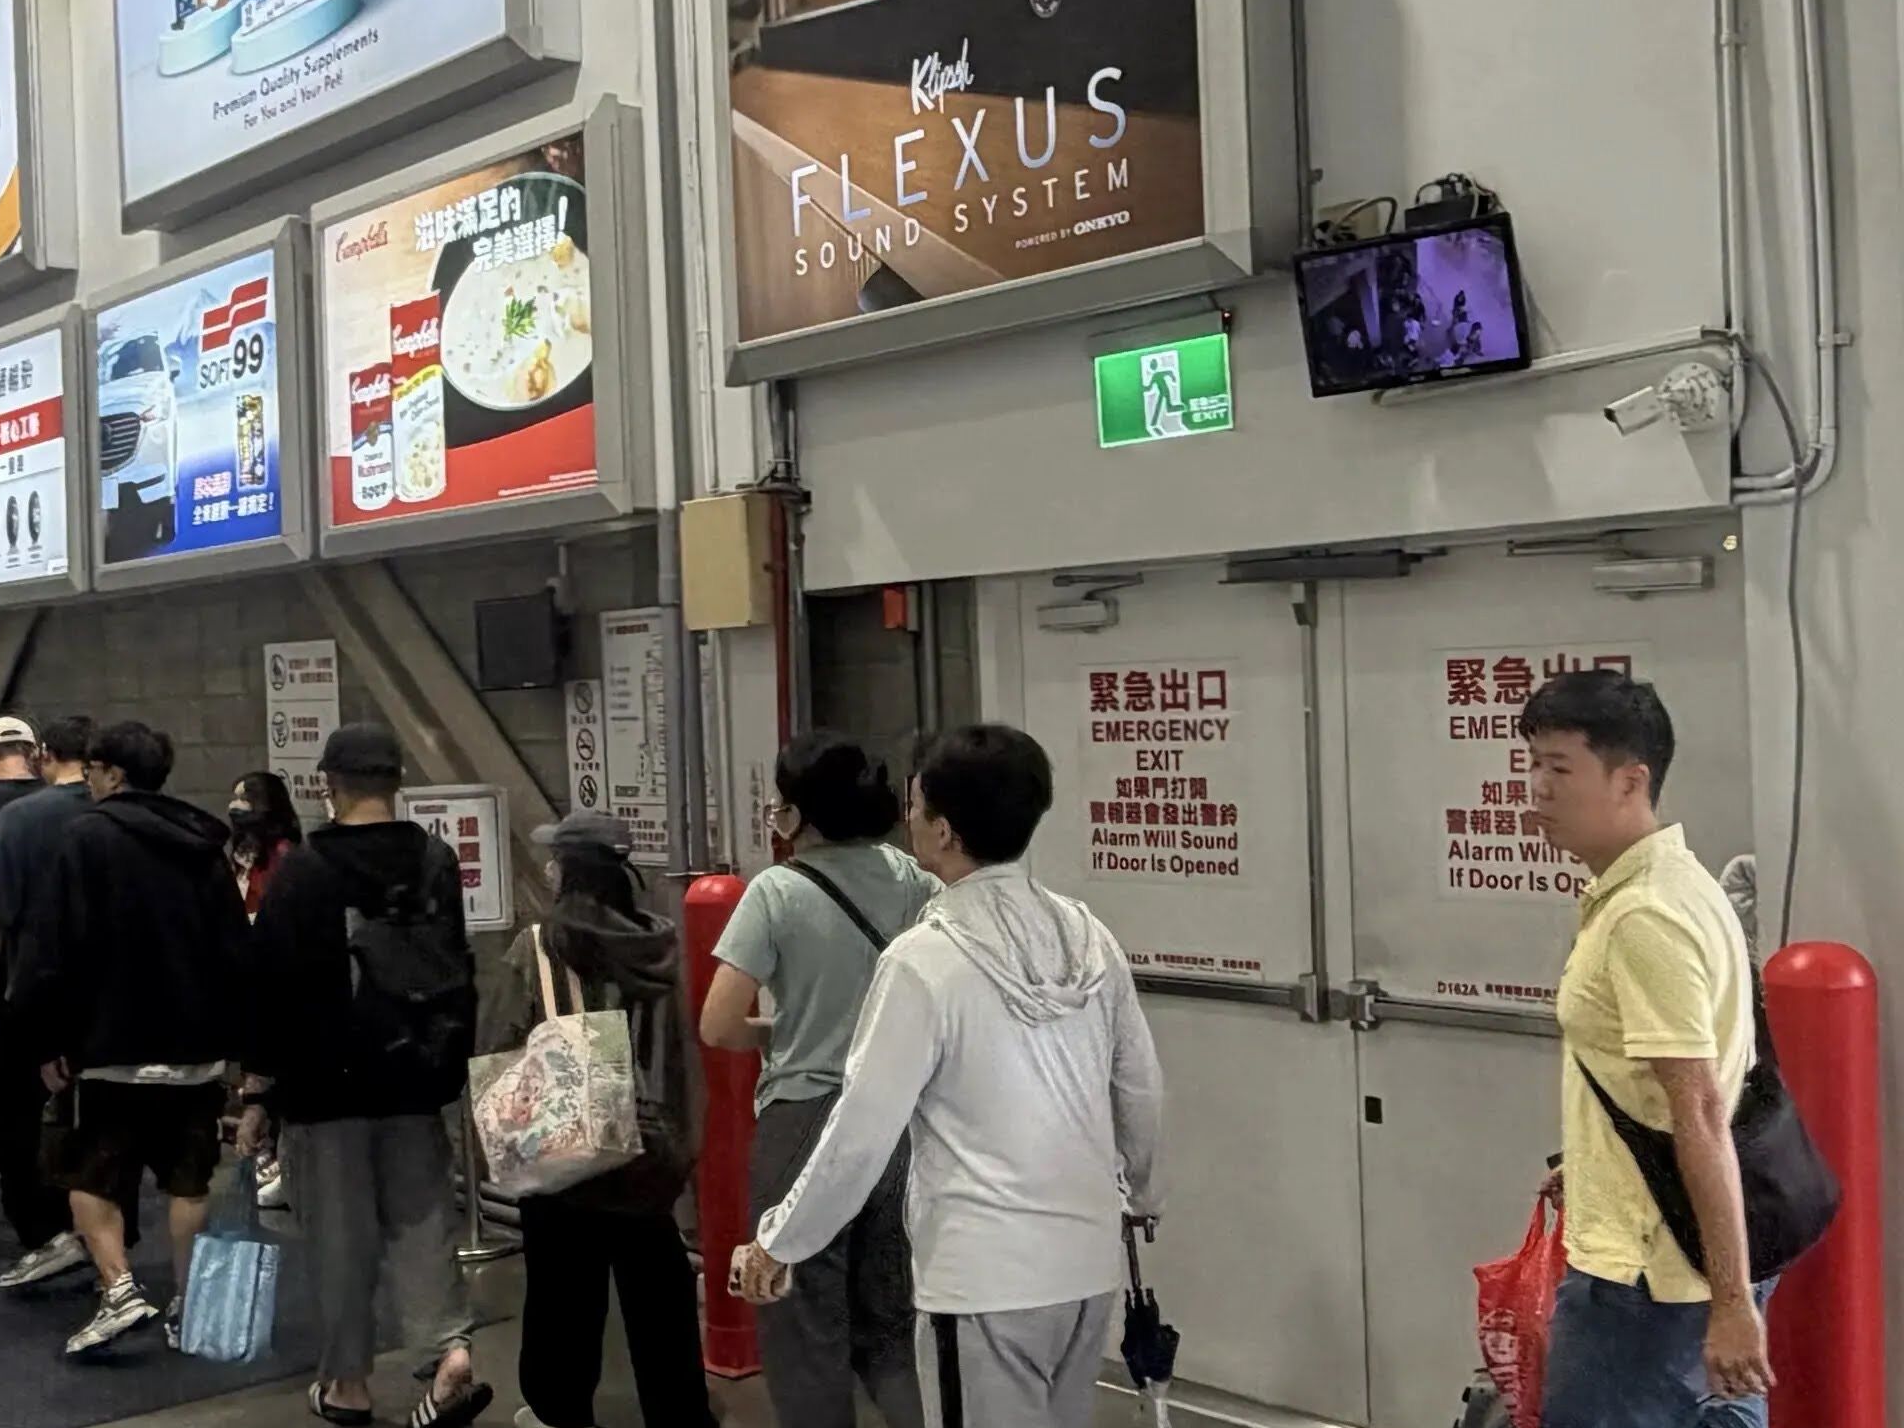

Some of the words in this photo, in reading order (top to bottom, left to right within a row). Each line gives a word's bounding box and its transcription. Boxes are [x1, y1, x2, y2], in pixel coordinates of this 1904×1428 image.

[213, 87, 257, 121] Premium
[259, 66, 301, 97] Quality
[303, 27, 380, 78] Supplements
[911, 37, 974, 115] Klipsch
[243, 113, 258, 130] For
[260, 104, 277, 121] You
[280, 96, 298, 113] and
[789, 67, 1126, 238] FLEXUS
[794, 217, 920, 276] SOUND
[954, 158, 1128, 233] SYSTEM
[1015, 230, 1058, 249] POWERED
[1061, 228, 1072, 239] BY
[1073, 210, 1131, 236] ONKYO
[1192, 409, 1228, 423] EXIT
[1090, 669, 1227, 712] 緊急出口
[1092, 719, 1230, 742] EMERGENCY
[1136, 749, 1183, 771] EXIT
[1116, 777, 1207, 799] 如果門打開
[1092, 828, 1140, 847] Alarm
[1144, 829, 1176, 848] Will
[1181, 831, 1238, 850] Sound
[1448, 840, 1513, 861] Alarm
[1107, 852, 1147, 872] Door
[1151, 854, 1166, 872] Is
[1170, 855, 1239, 877] Opened
[1449, 868, 1464, 887] If
[1469, 869, 1523, 890] Door
[1529, 871, 1549, 891] Is
